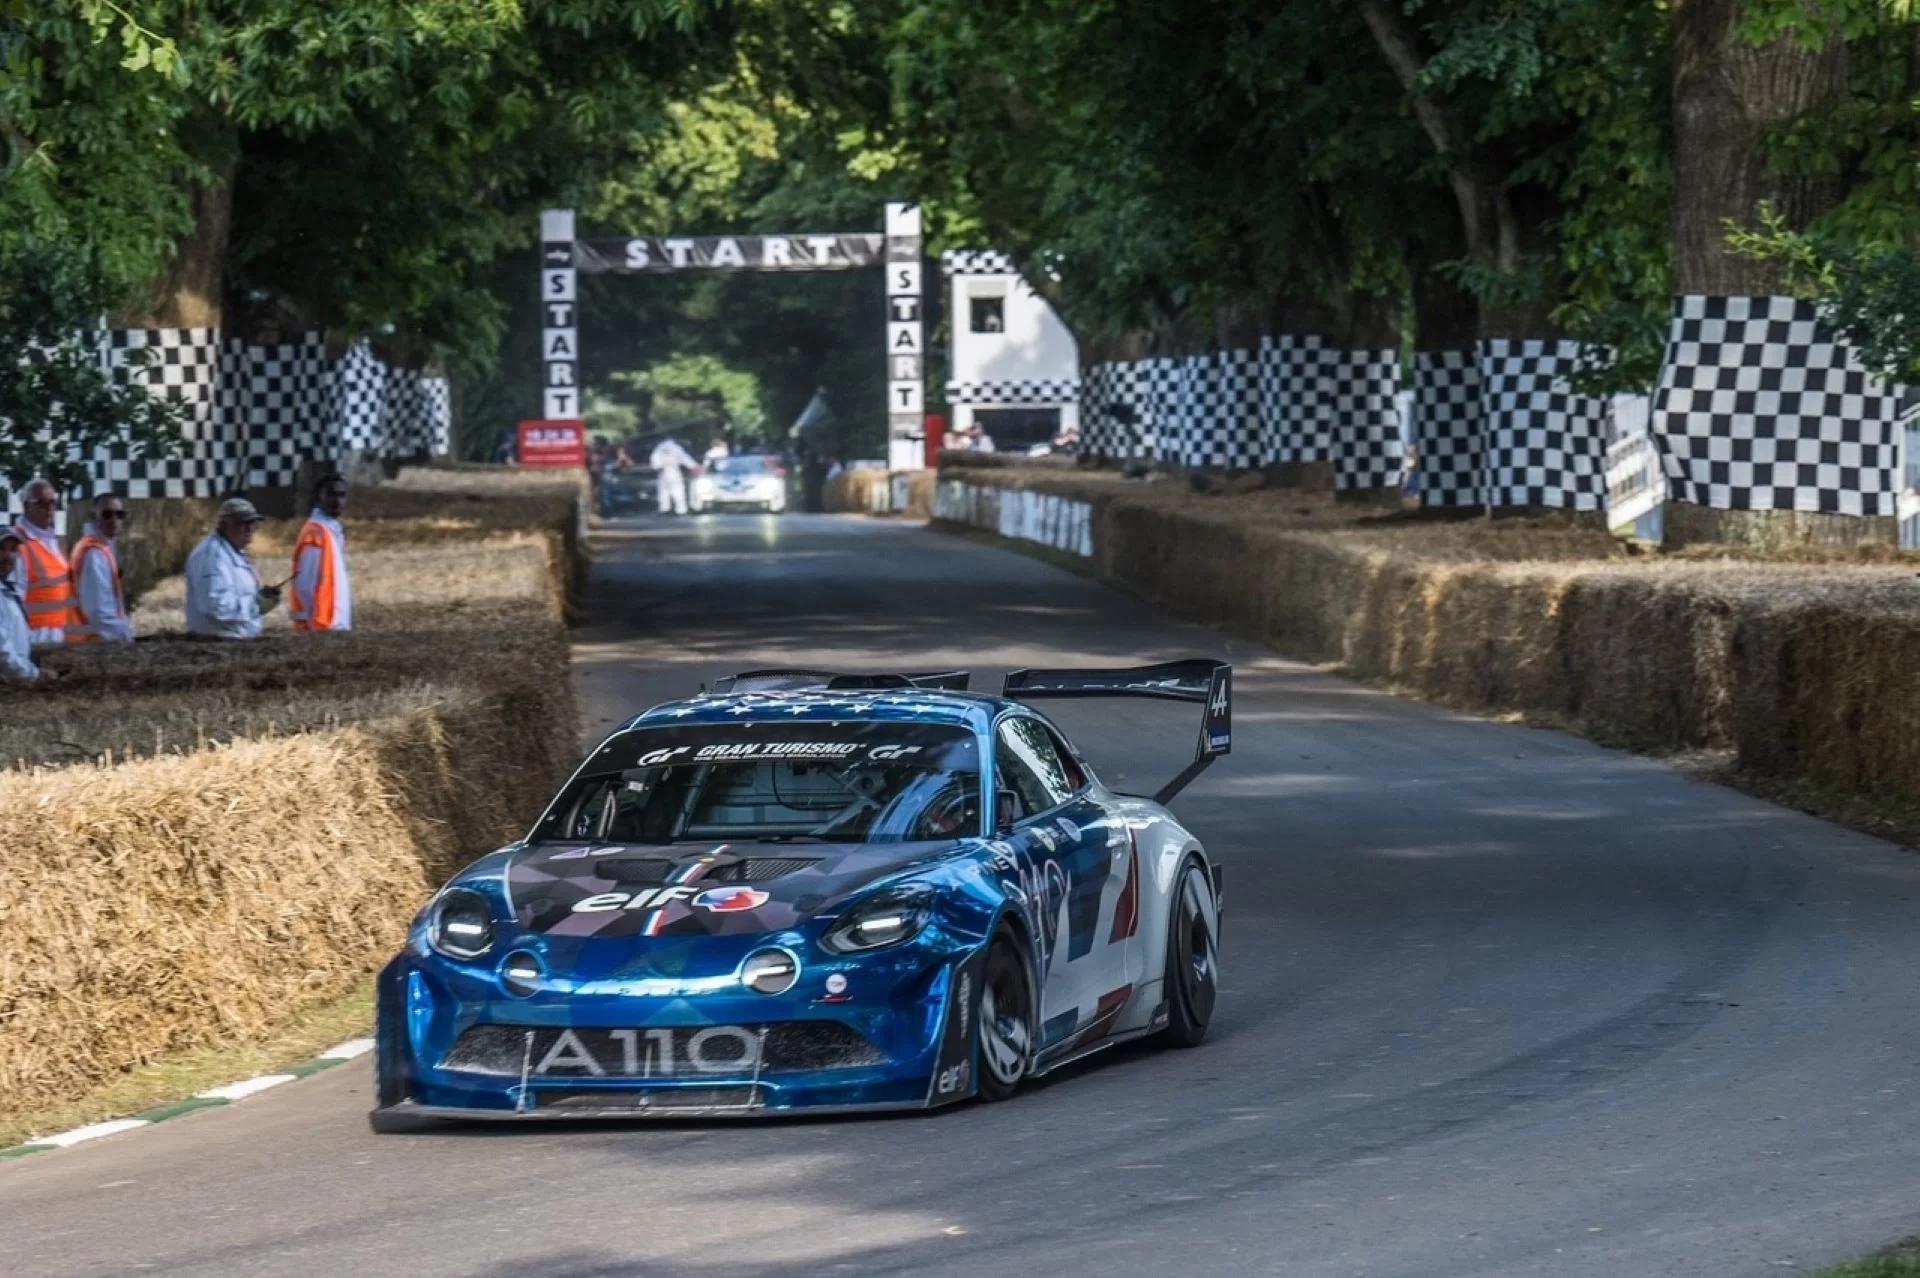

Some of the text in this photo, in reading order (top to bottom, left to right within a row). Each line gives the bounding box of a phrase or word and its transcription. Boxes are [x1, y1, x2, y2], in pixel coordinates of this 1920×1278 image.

[625, 236, 837, 268] START
[549, 273, 574, 414] START
[893, 269, 919, 407] START
[696, 743, 761, 757] GRAN
[761, 742, 858, 754] TURISMO
[571, 885, 699, 913] elf
[534, 1025, 764, 1076] A110
